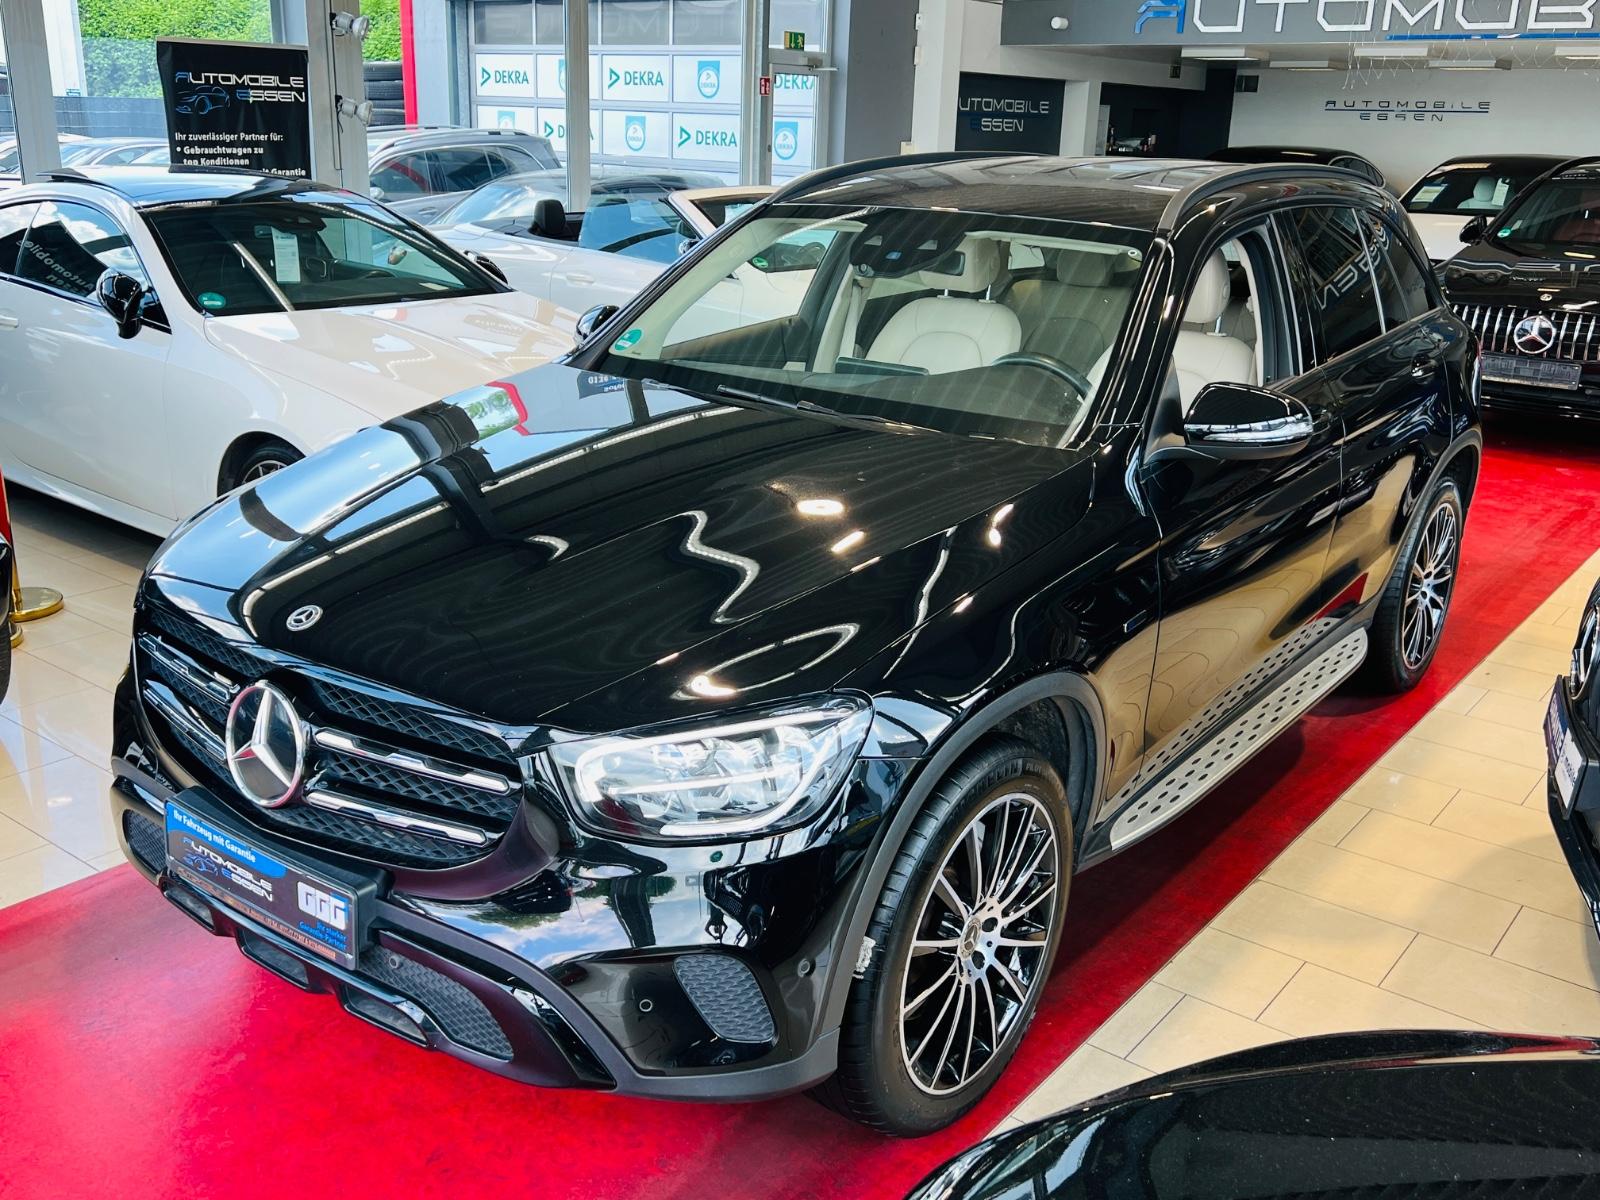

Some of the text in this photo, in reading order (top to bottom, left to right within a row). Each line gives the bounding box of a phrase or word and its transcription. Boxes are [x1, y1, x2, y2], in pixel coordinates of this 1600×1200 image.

[1134, 0, 1594, 33] AUTOMOB
[175, 72, 305, 88] AUTOMOBILE
[494, 70, 530, 84] DEKRA
[624, 70, 664, 86] DEKRA
[235, 89, 306, 103] ESSEN
[958, 97, 1050, 114] UTOMOBILE
[1325, 100, 1491, 110] AUTOMOBILE
[1359, 112, 1444, 122] ESSEN
[175, 132, 284, 143] Ihr zuverlässiger Partner für:
[695, 130, 738, 148] DEKRA
[183, 145, 264, 156] Gebrauchtwagen zu
[200, 157, 250, 166] Konditionen
[270, 168, 307, 176] Garantie
[173, 809, 256, 863] Ihr Fahrzeug mit Garantie
[183, 837, 273, 892] AUTOMOBILE
[221, 867, 273, 902] ESSEN
